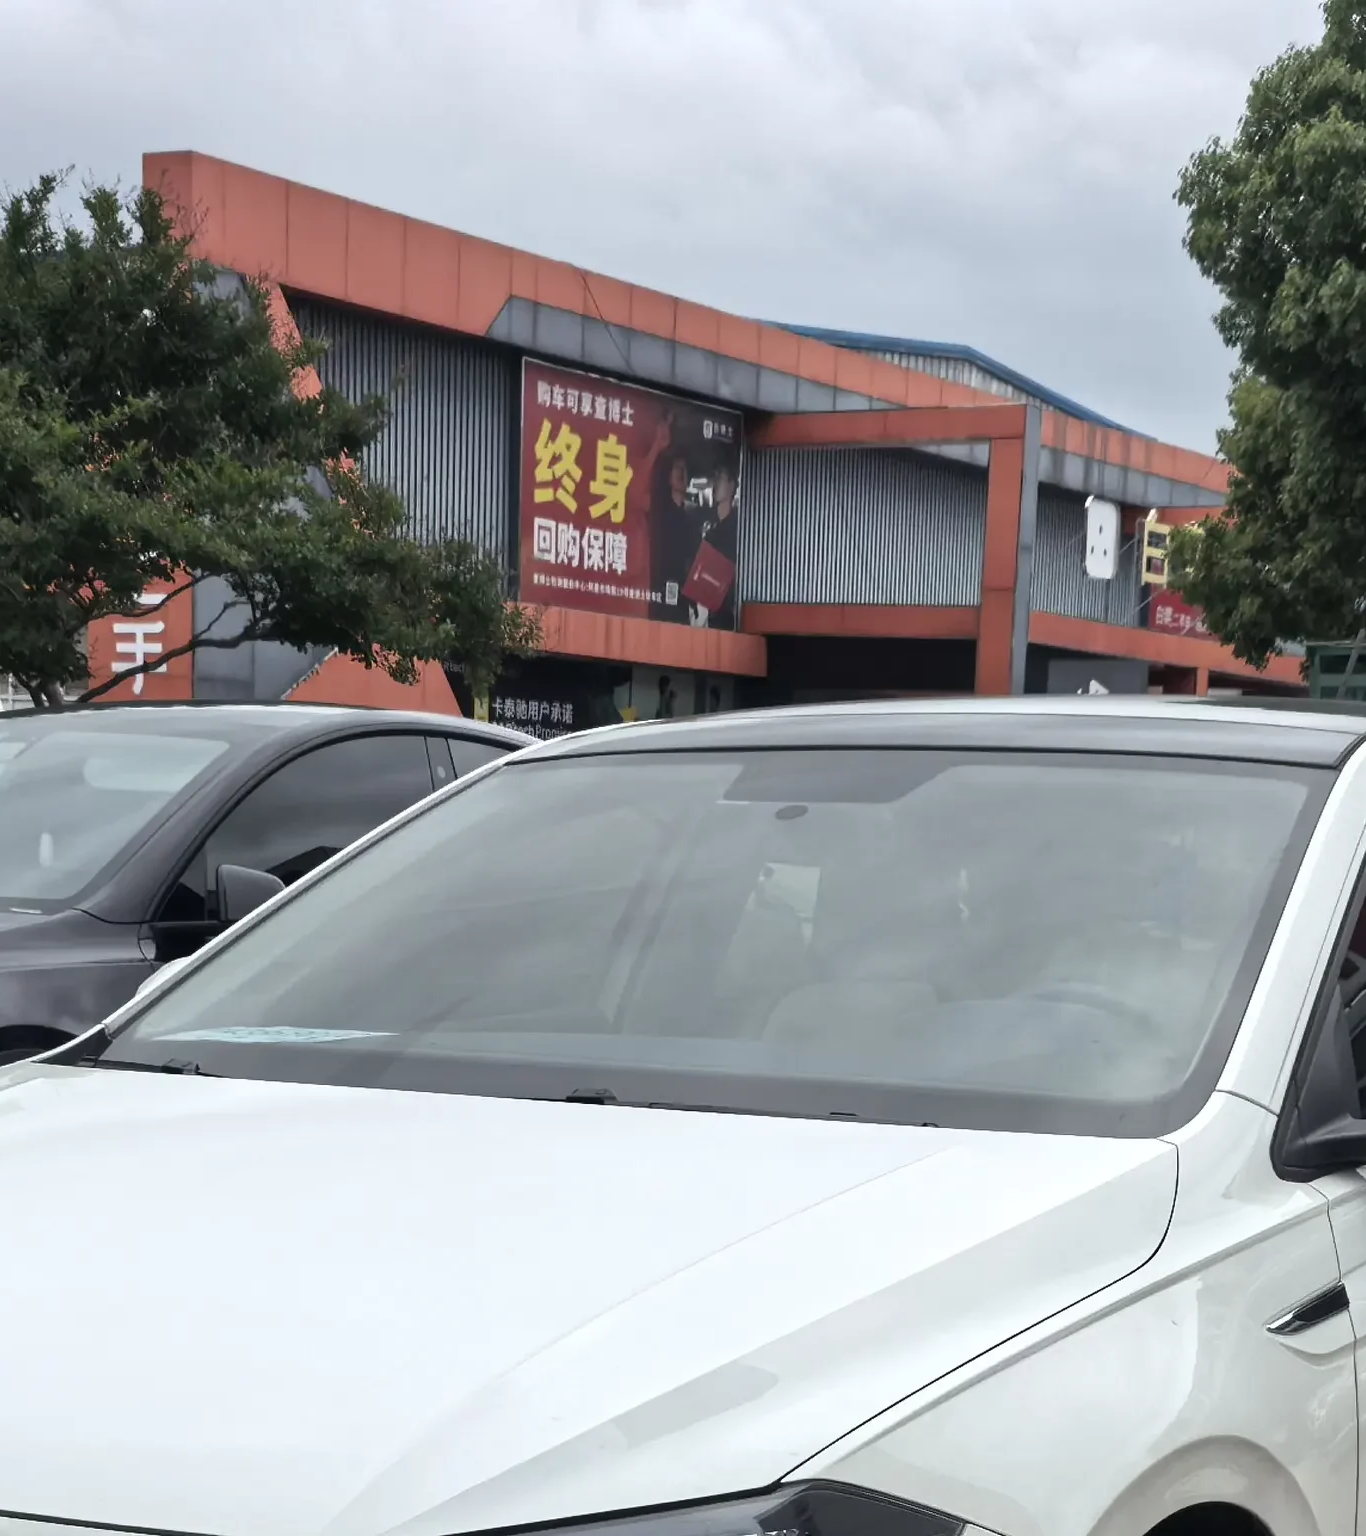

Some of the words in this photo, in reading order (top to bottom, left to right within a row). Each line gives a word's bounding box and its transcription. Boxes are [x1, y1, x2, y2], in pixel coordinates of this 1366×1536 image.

[537, 379, 634, 427] 购车可享查博士
[534, 418, 633, 524] 终身
[533, 517, 628, 574] 回购保障
[492, 696, 573, 724] 卡泰驰用户承诺
